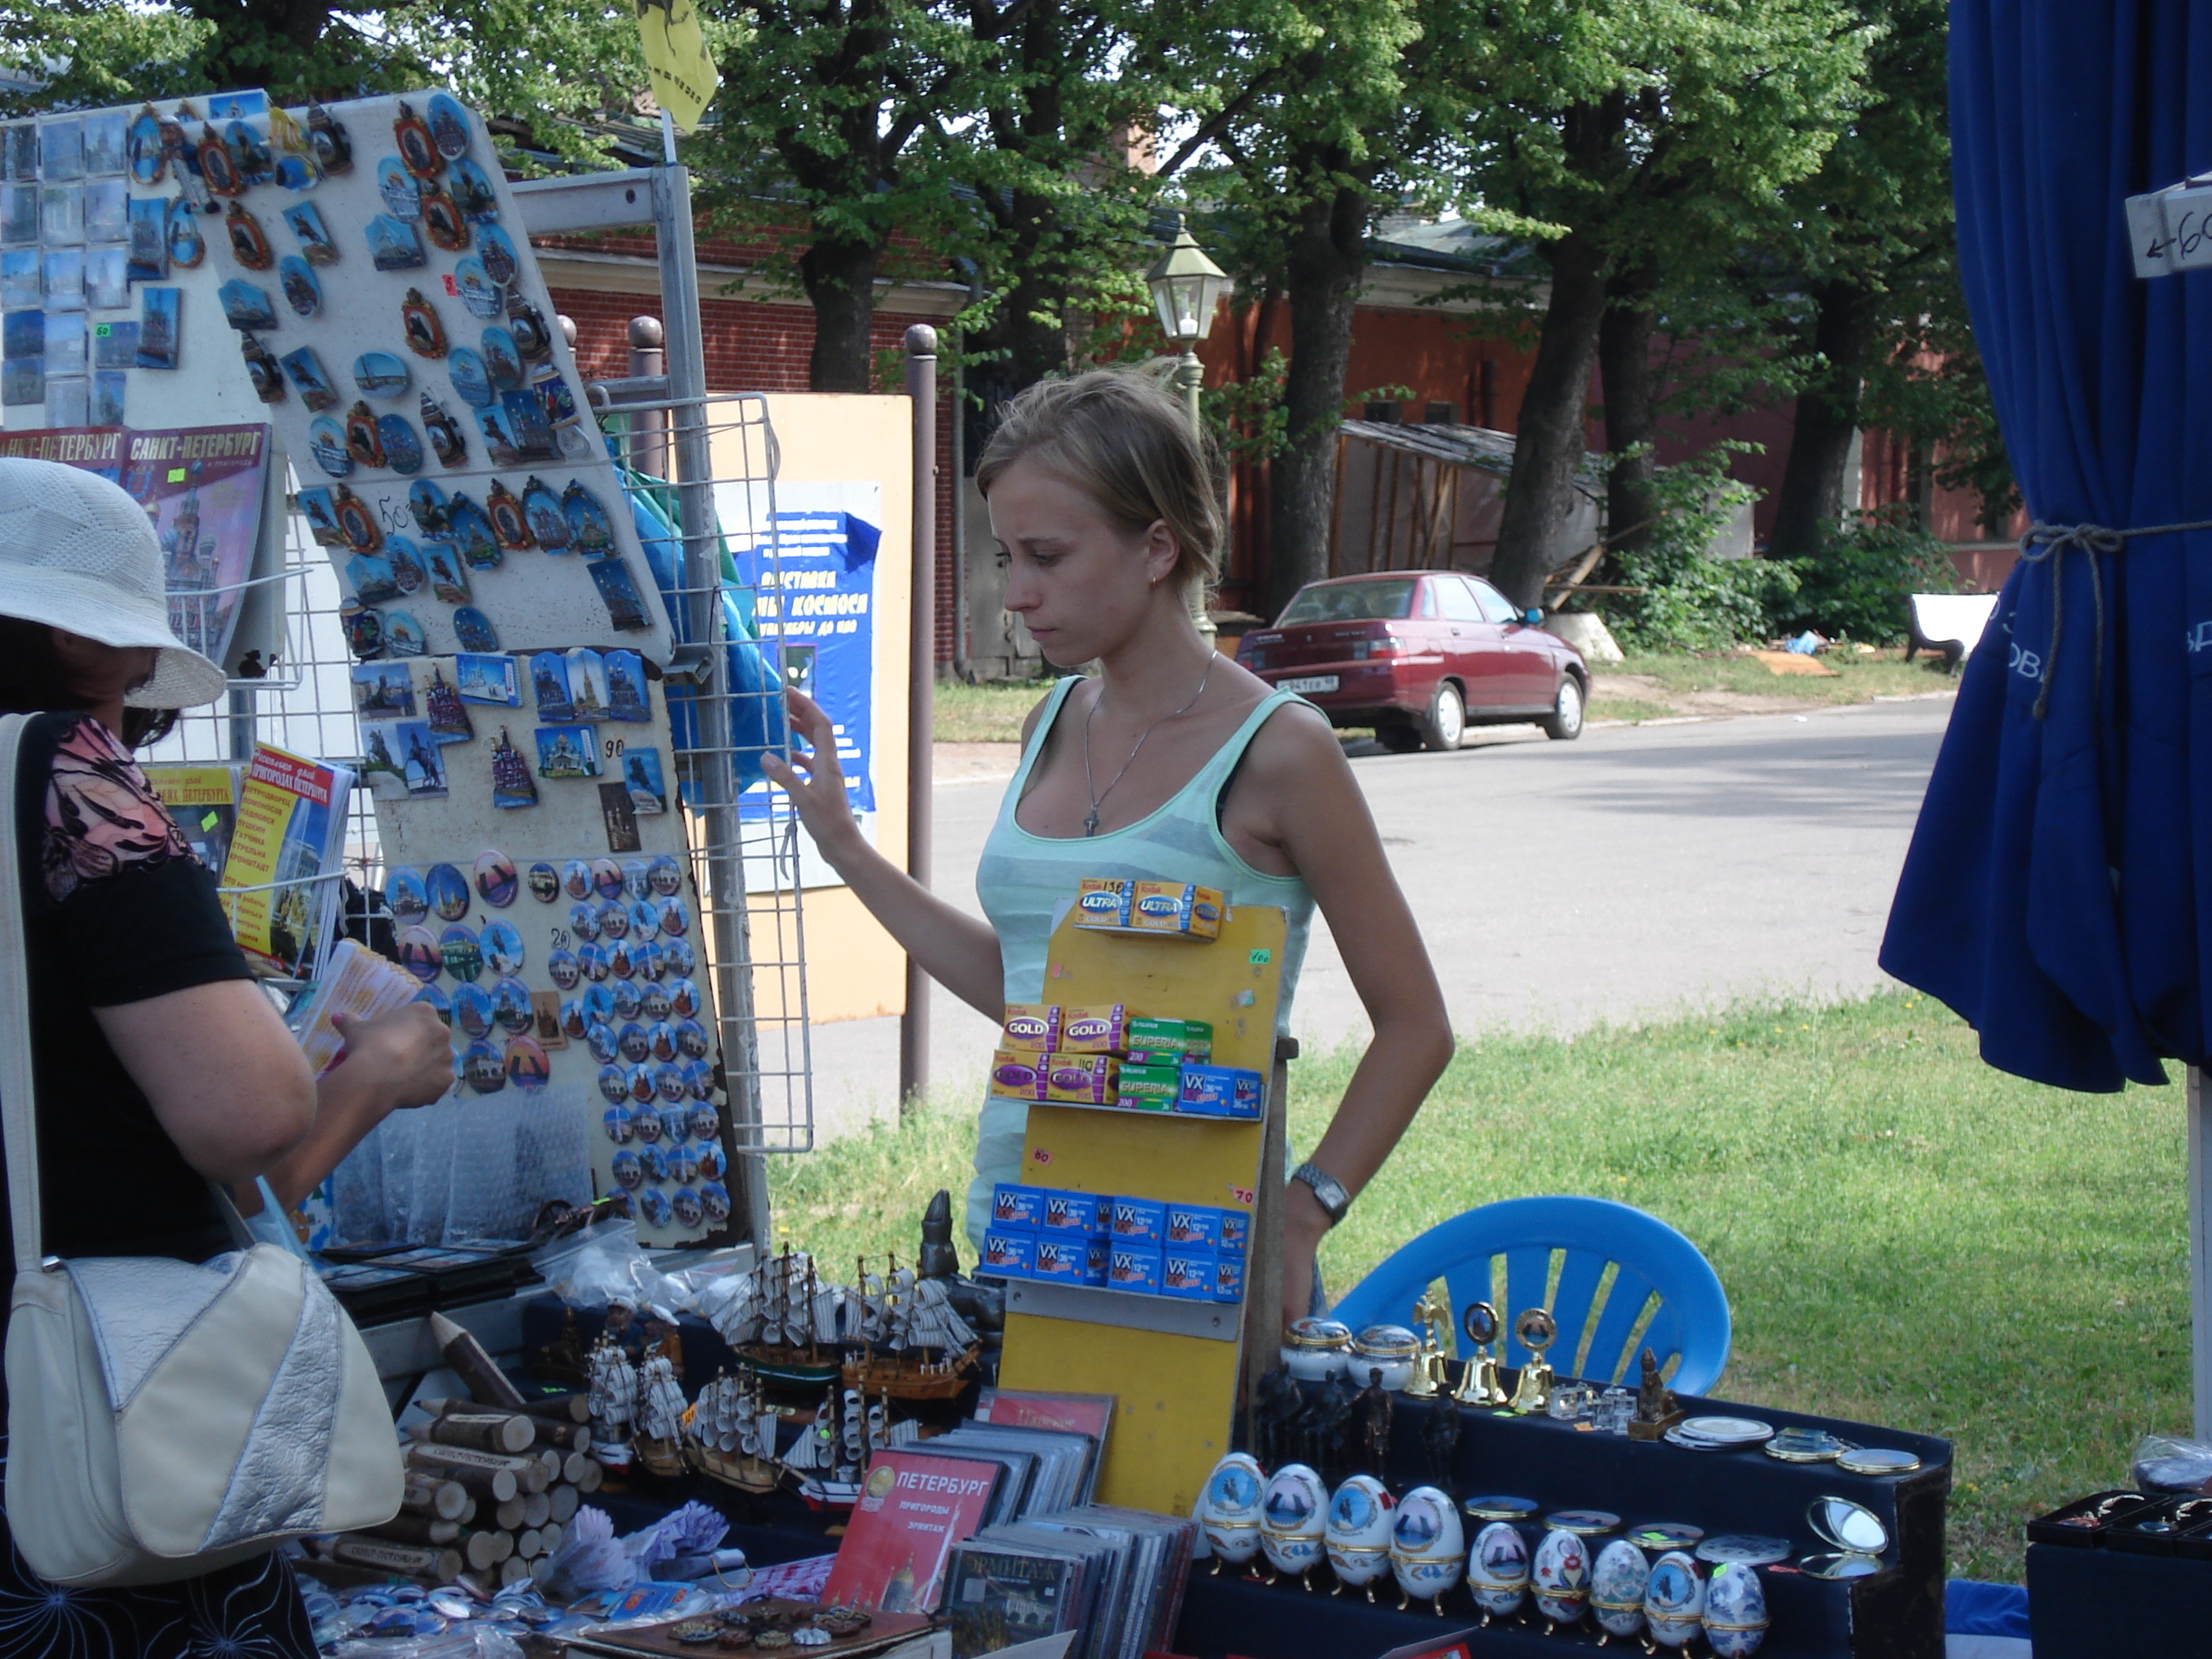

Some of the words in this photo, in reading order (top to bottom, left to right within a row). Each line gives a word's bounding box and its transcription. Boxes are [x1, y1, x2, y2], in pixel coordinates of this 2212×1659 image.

[97, 326, 108, 335] 60
[130, 432, 261, 460] САНКТ-ПЕТЕРБУРГ
[606, 739, 624, 759] 90
[183, 788, 229, 802] ПЕТЕРБУРГА
[240, 808, 275, 825] ПАВЛОВСК
[238, 819, 266, 833] ПУШКИН
[235, 830, 265, 846] ГАТЧИНА
[232, 842, 266, 859] СТРЕЛЬНА
[229, 853, 269, 872] КРОНШТАДТ
[1103, 881, 1124, 895] 130
[1082, 896, 1117, 908] ULTRA
[1141, 900, 1177, 913] ULTRA
[1009, 1023, 1043, 1035] GOLD
[1069, 1025, 1106, 1036] GOLD
[1133, 1035, 1178, 1049] SUPERIA
[995, 1054, 1016, 1063] Kodak
[1129, 1052, 1143, 1060] 200
[997, 1070, 1033, 1081] GOLD
[1053, 1072, 1090, 1083] GOLD
[1186, 1075, 1204, 1090] VX
[1121, 1082, 1170, 1095] SUPERIA
[1118, 1098, 1133, 1107] 200
[999, 1193, 1016, 1207] VX
[1236, 1190, 1253, 1203] 70
[1049, 1199, 1068, 1214] VX
[1117, 1206, 1135, 1222] VX
[1172, 1214, 1191, 1229] VX
[989, 1238, 1006, 1253] VX
[1040, 1244, 1058, 1260] VX
[1114, 1254, 1132, 1269] VX
[1168, 1260, 1187, 1276] VX
[897, 1471, 989, 1496] ПЕТЕРБУРГ
[899, 1500, 950, 1515] ПРИГОРОДЫ
[908, 1521, 946, 1533] ЭРМИТАЖ
